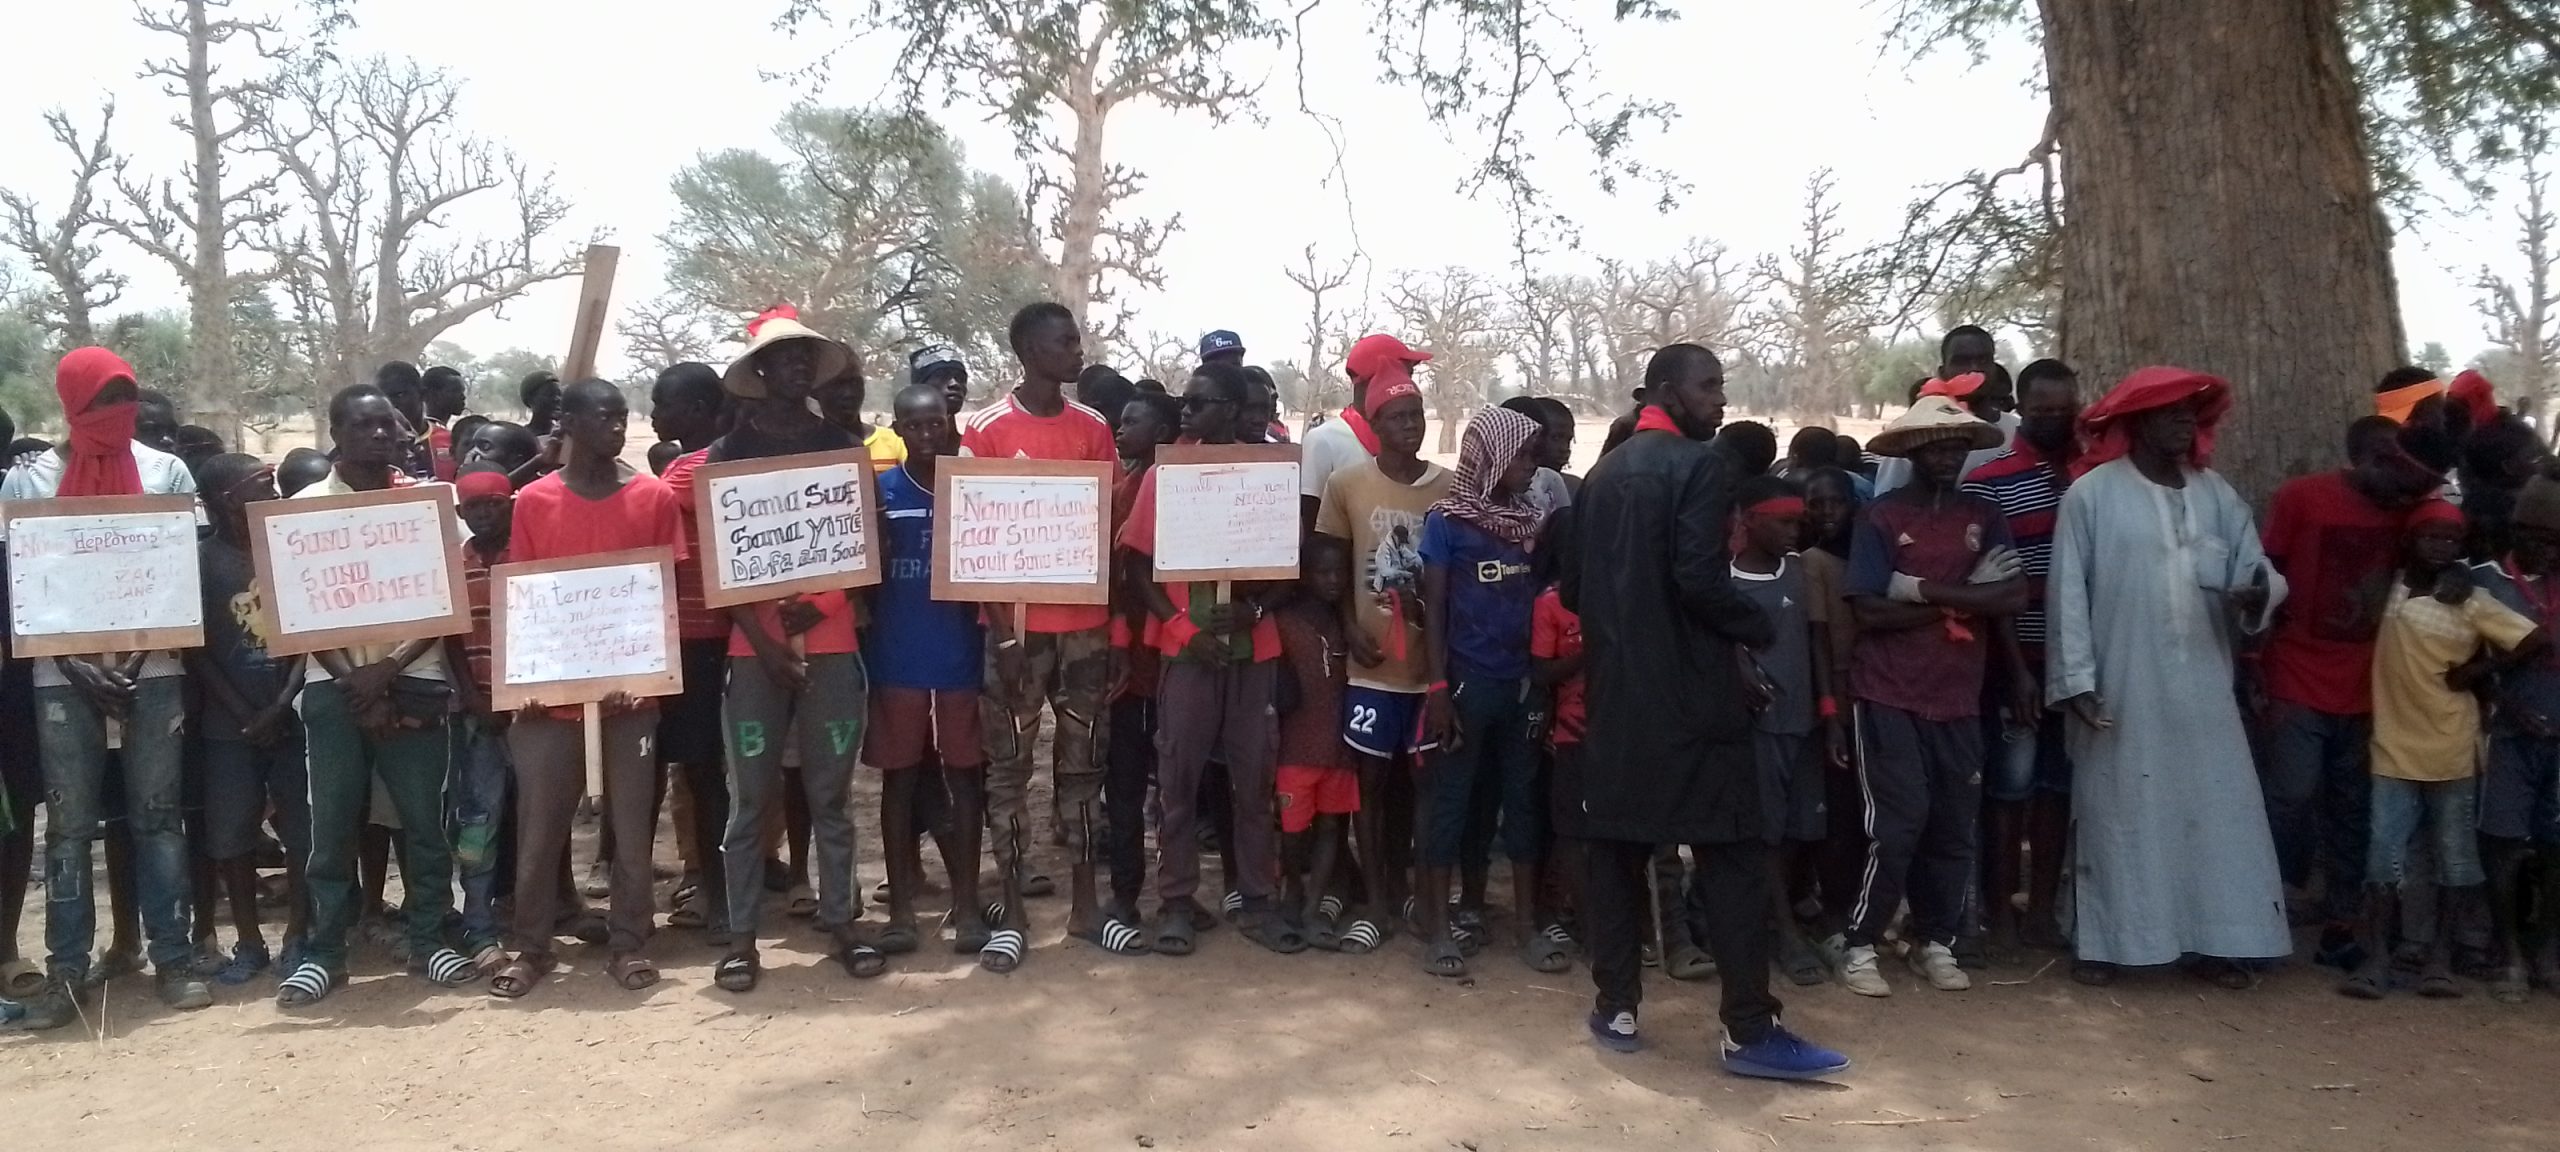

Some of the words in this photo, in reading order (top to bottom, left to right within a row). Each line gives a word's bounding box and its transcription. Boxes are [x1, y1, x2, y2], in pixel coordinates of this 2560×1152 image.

[722, 487, 801, 522] Sama
[287, 527, 350, 559] SUNU
[731, 522, 805, 556] Sama
[302, 560, 370, 593] SUNU
[732, 551, 793, 582] Dafa
[515, 584, 548, 610] Ma
[552, 580, 601, 606] terre
[610, 575, 638, 598] est
[1350, 704, 1377, 735] 22
[738, 720, 765, 757] B
[825, 720, 858, 755] V
